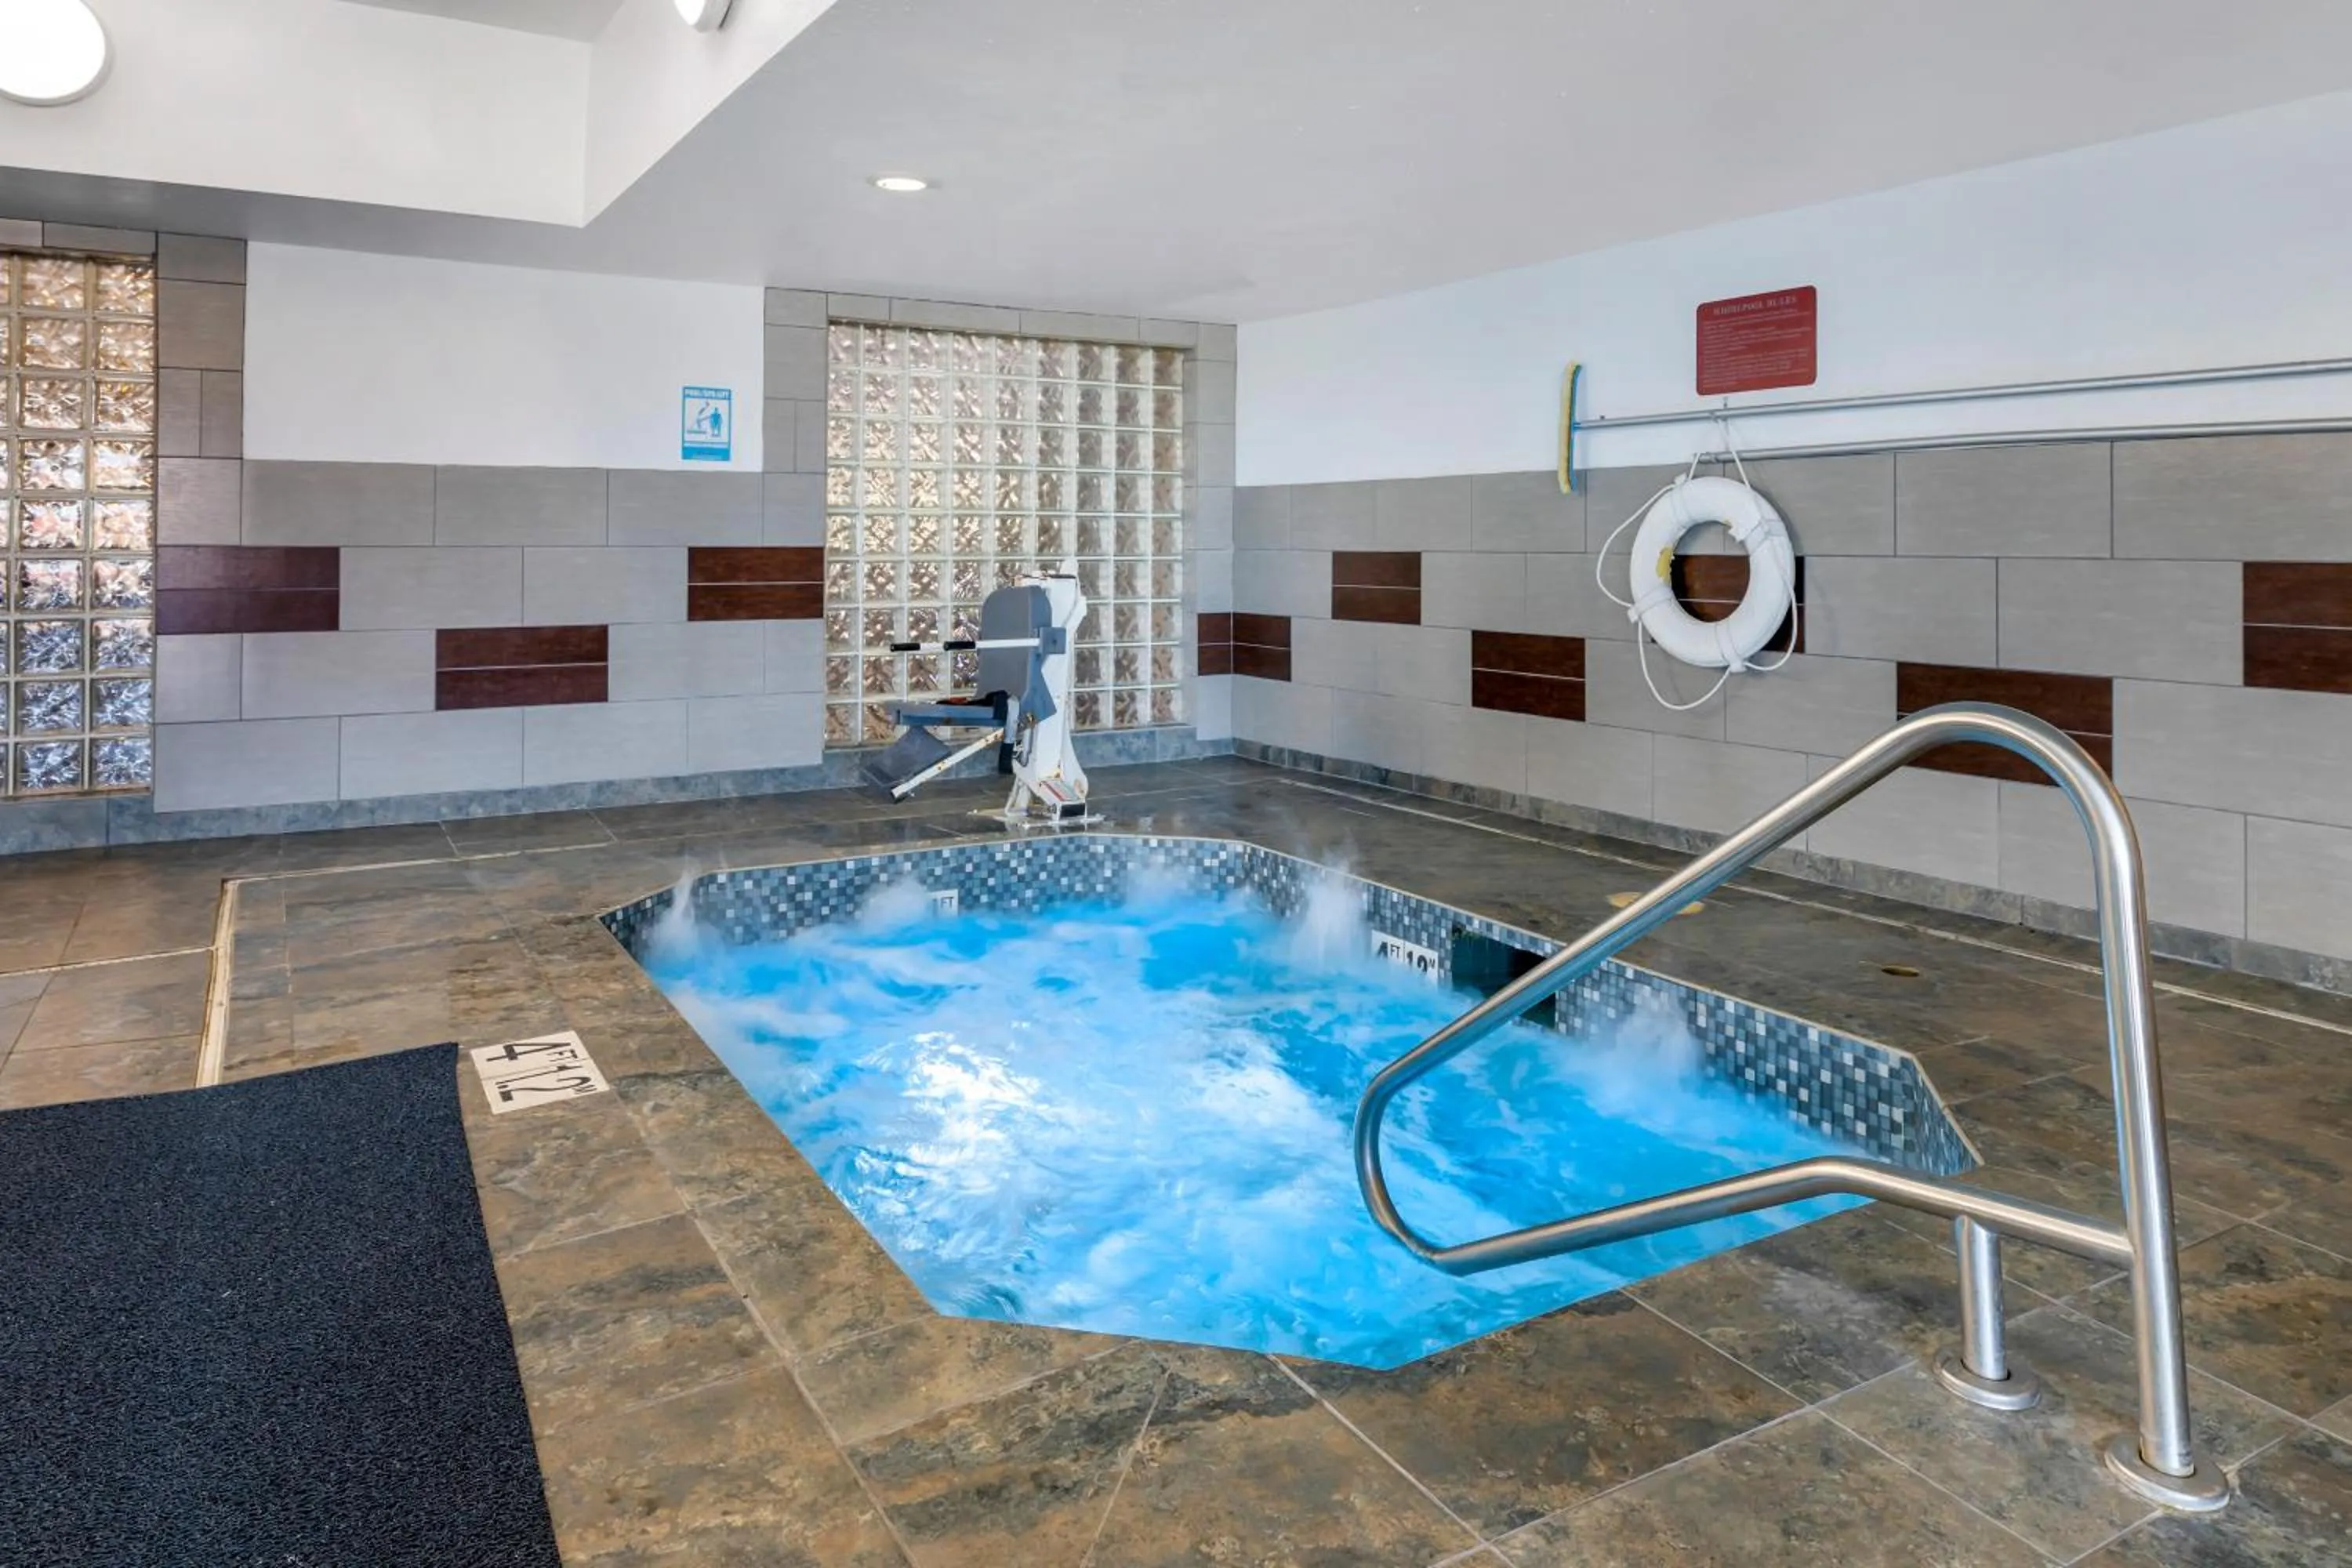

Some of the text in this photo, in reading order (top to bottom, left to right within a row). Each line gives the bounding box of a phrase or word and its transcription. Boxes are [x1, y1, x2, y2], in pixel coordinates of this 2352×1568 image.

[1390, 943, 1400, 959] FT
[486, 1041, 571, 1062] 4
[546, 1049, 578, 1062] FT
